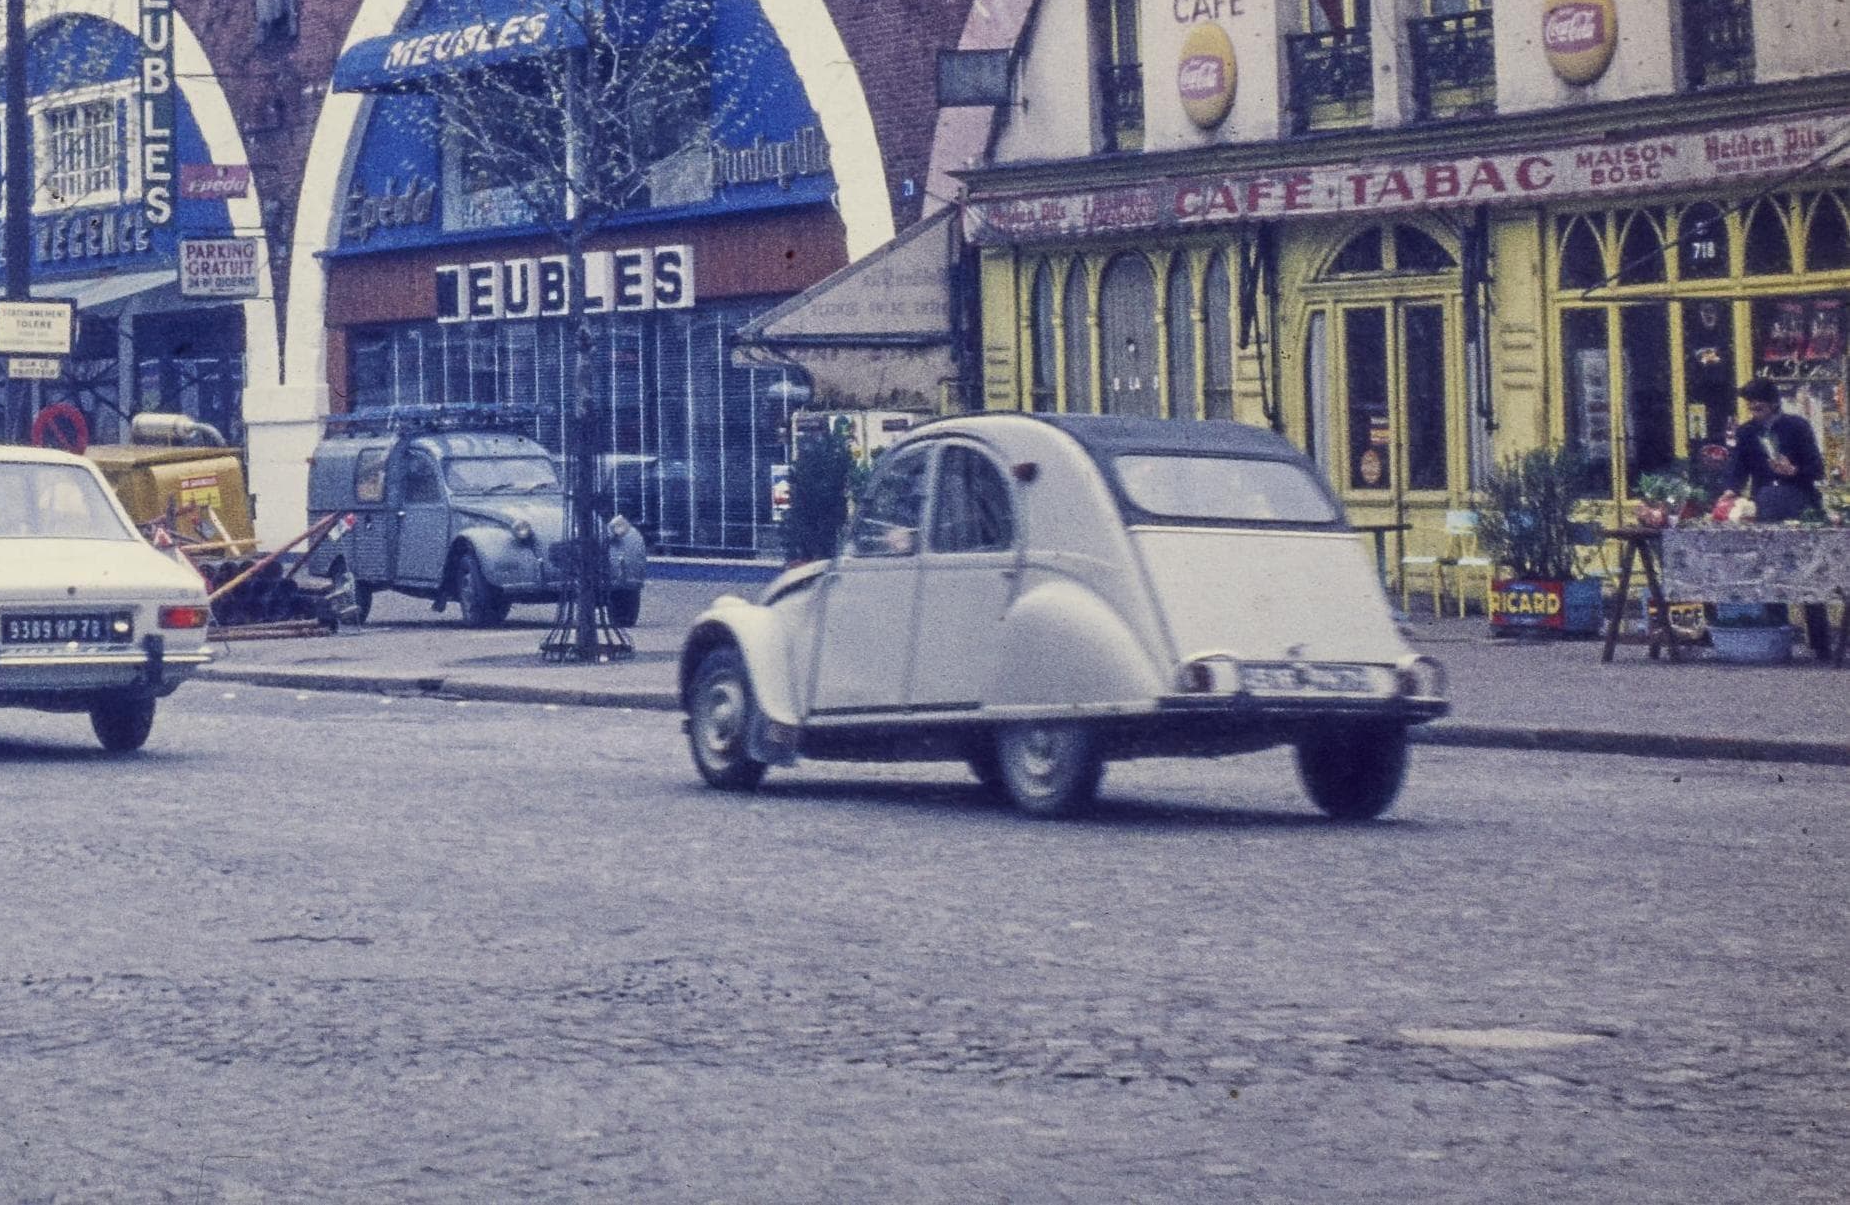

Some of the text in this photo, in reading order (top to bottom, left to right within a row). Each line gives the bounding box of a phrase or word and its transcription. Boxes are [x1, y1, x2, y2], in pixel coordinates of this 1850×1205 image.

[383, 12, 549, 71] MEUBLES
[1575, 143, 1677, 169] MAISON
[1346, 155, 1555, 207] TABAC
[1590, 163, 1662, 186] BOSC
[186, 242, 255, 259] PARKING
[187, 260, 254, 276] GRATUIT
[1489, 592, 1561, 616] RICARD
